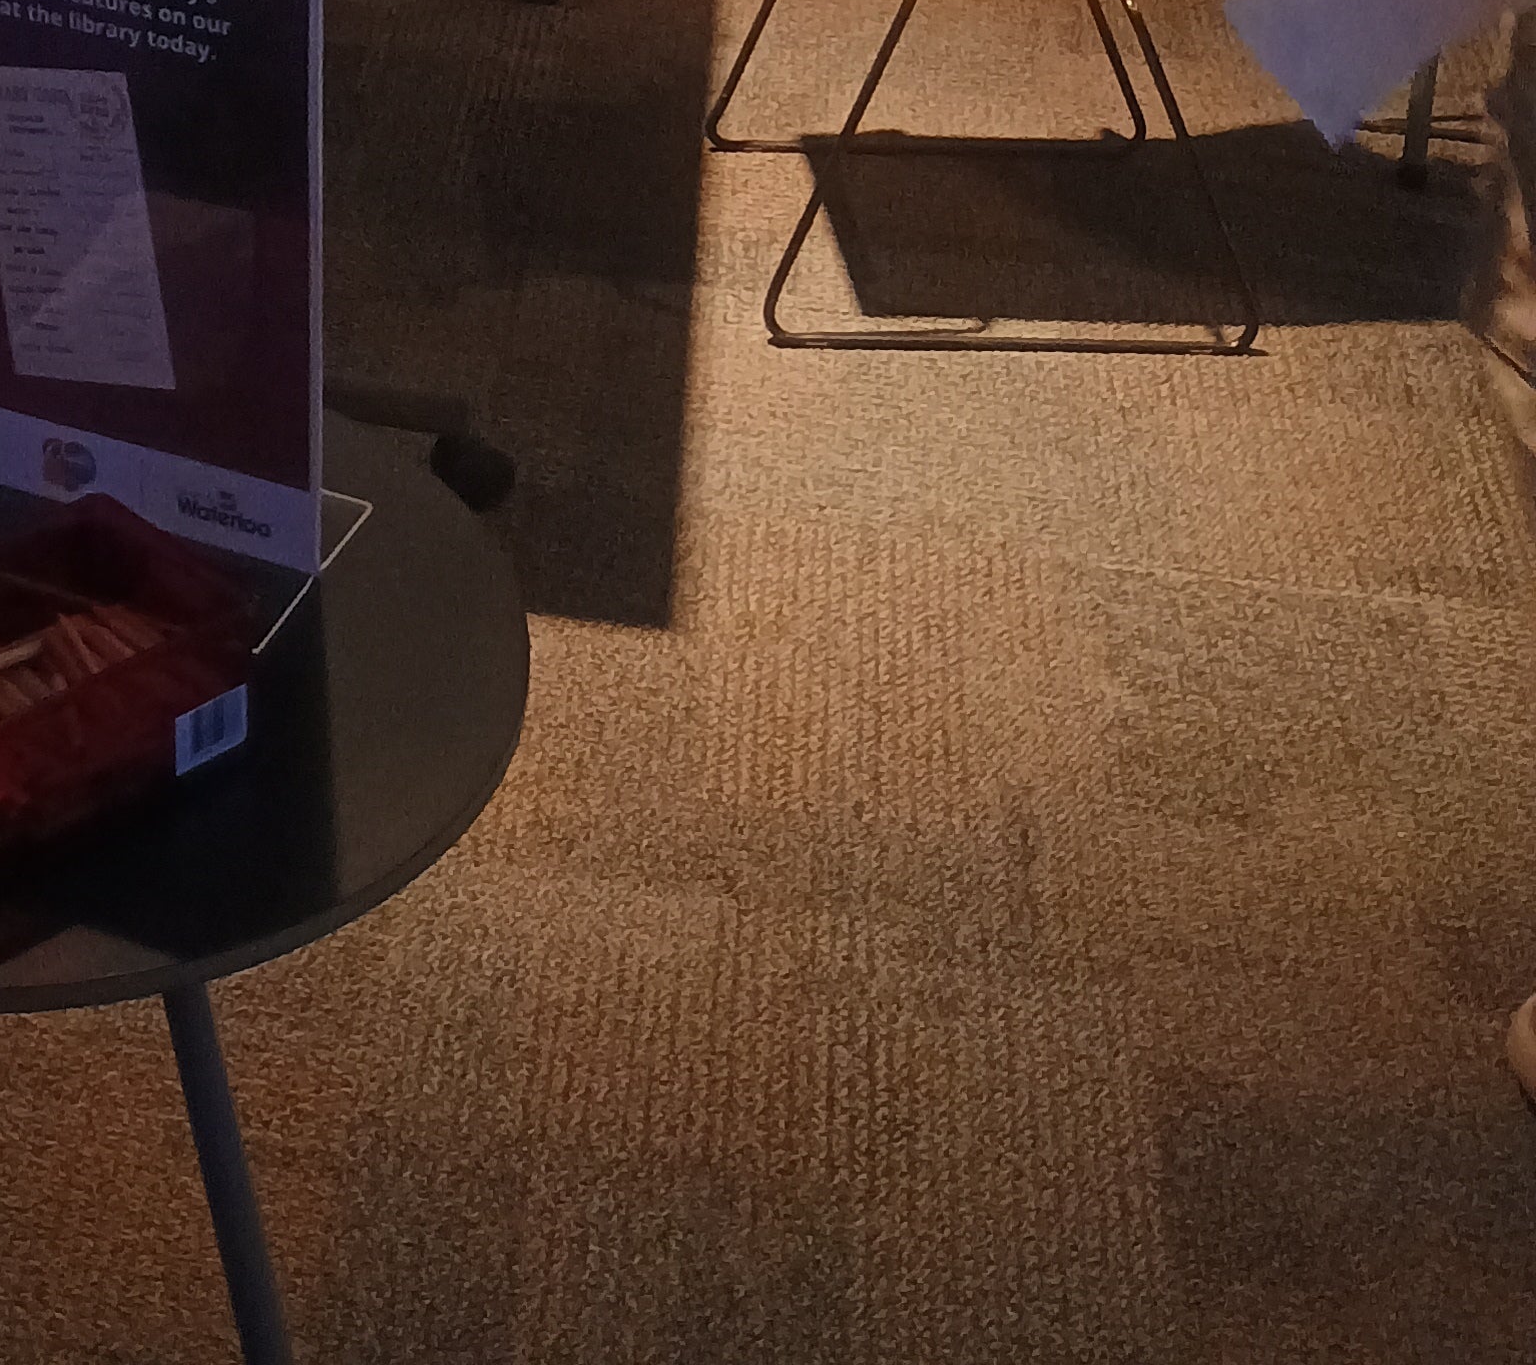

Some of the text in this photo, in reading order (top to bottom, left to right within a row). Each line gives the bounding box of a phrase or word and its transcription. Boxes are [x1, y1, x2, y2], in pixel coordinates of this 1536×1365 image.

[27, 2, 63, 28] the
[68, 11, 141, 48] library
[147, 30, 217, 64] today.
[158, 6, 187, 25] on
[192, 14, 232, 37] our
